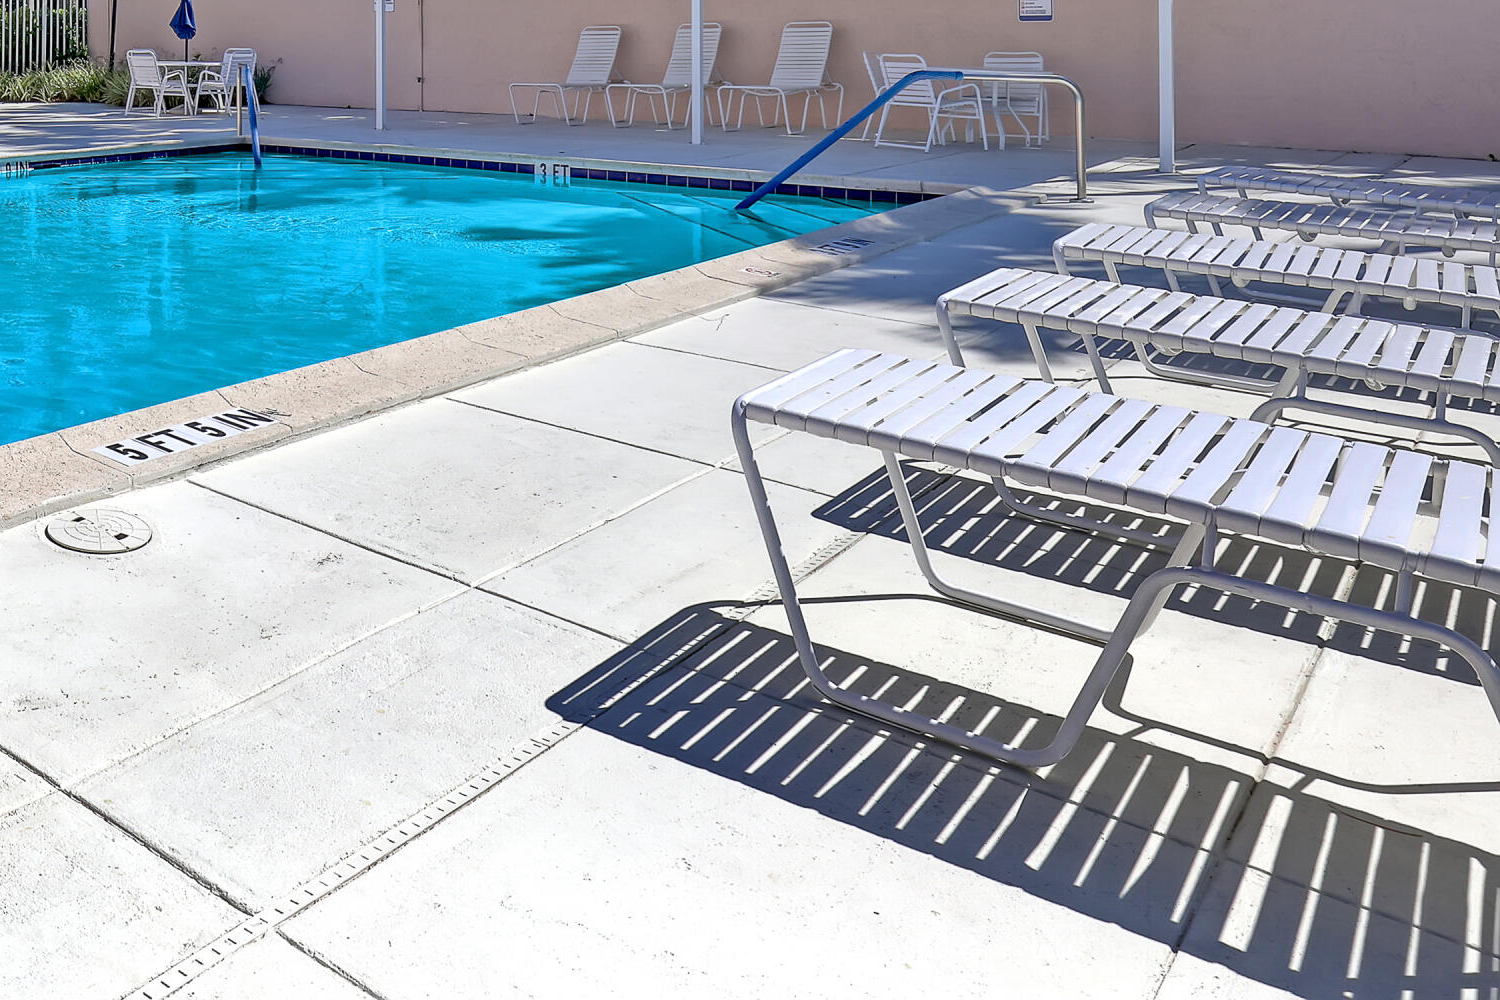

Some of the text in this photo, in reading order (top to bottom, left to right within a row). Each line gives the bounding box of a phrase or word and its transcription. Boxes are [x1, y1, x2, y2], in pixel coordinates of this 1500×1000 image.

[105, 409, 275, 461] 5 FT 5 IN
